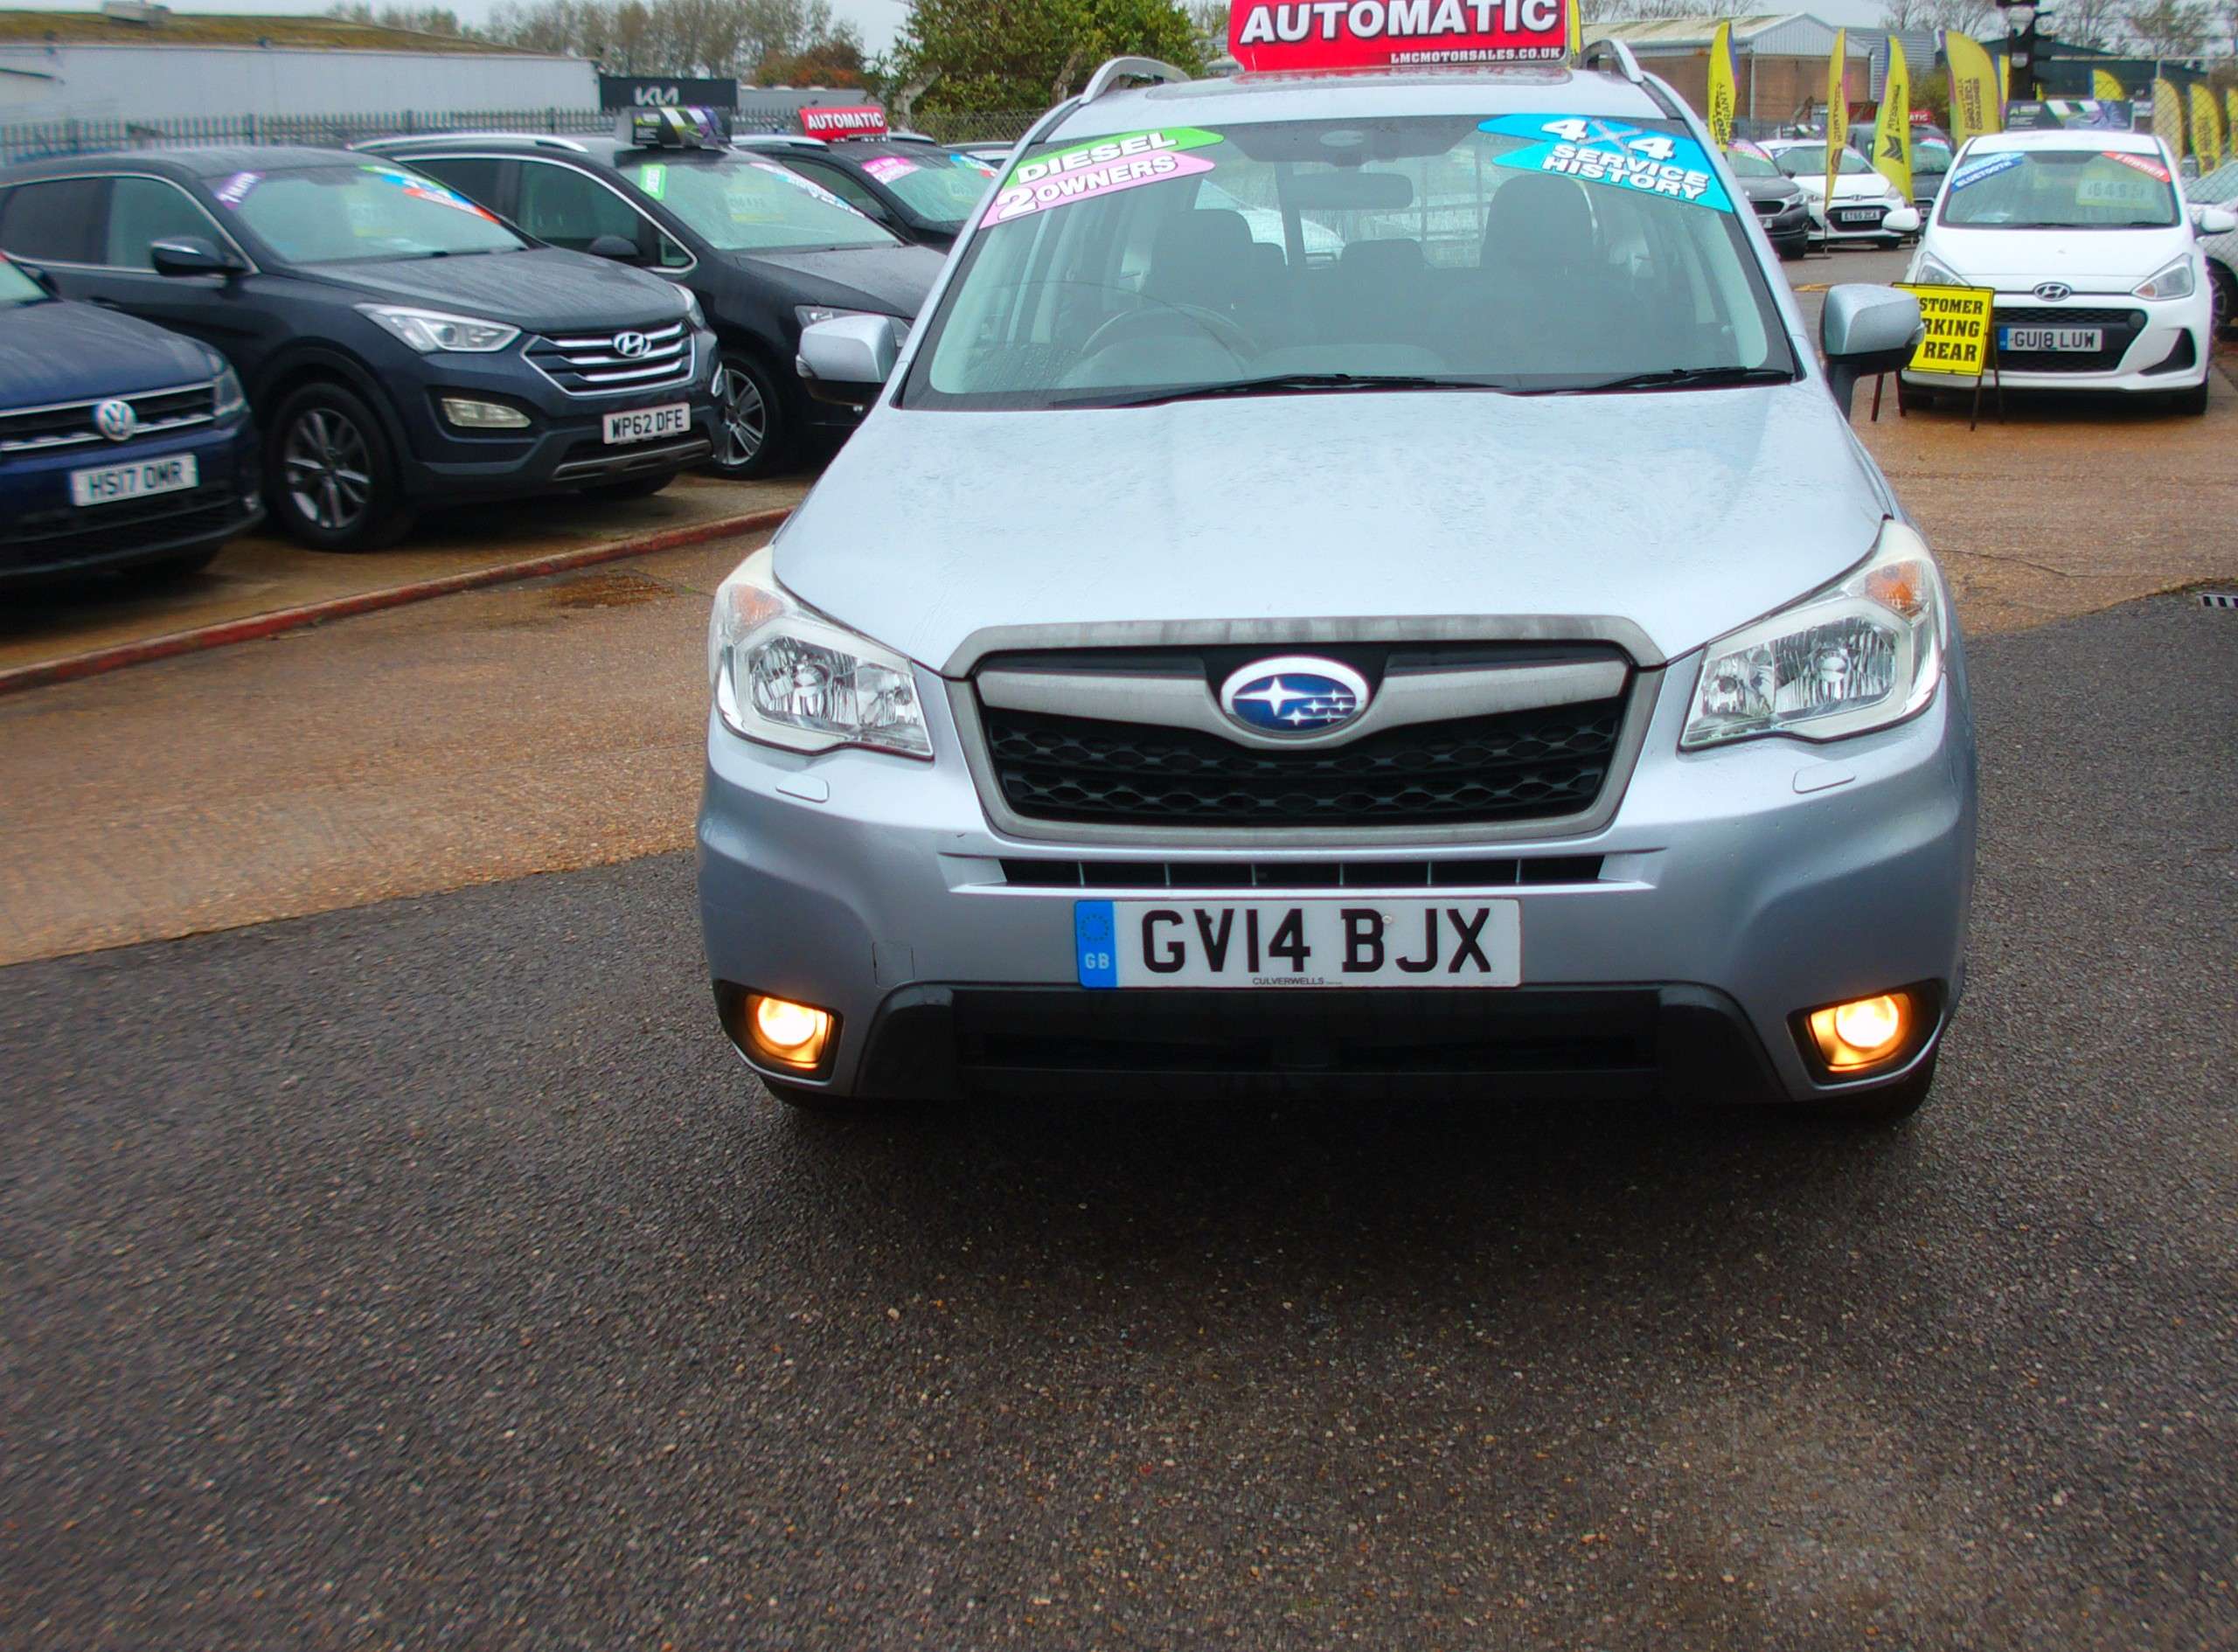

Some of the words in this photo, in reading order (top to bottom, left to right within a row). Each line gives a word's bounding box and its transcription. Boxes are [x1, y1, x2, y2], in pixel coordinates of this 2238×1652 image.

[1240, 0, 1559, 44] AUTOMATIC
[1390, 47, 1561, 65] LMCMOTORSALES.CO.UK
[634, 87, 678, 106] KIA
[806, 112, 885, 130] AUTOMATIC
[1017, 132, 1177, 184] DIESEL
[1552, 143, 1709, 189] SERVICE
[997, 187, 1039, 220] 2
[1034, 155, 1179, 202] OWNERS
[1541, 156, 1706, 200] HISTORY
[1916, 297, 1984, 315] STOMER
[1922, 318, 1981, 338] RKING
[2060, 331, 2096, 348] LUW
[1923, 341, 1977, 362] REAR
[612, 414, 652, 438] WP62
[656, 408, 684, 432] DFE
[1084, 954, 1110, 970] GB
[1141, 907, 1312, 974] GV14
[1339, 907, 1492, 974] BJX
[1252, 976, 1325, 986] CULVERWELLS
